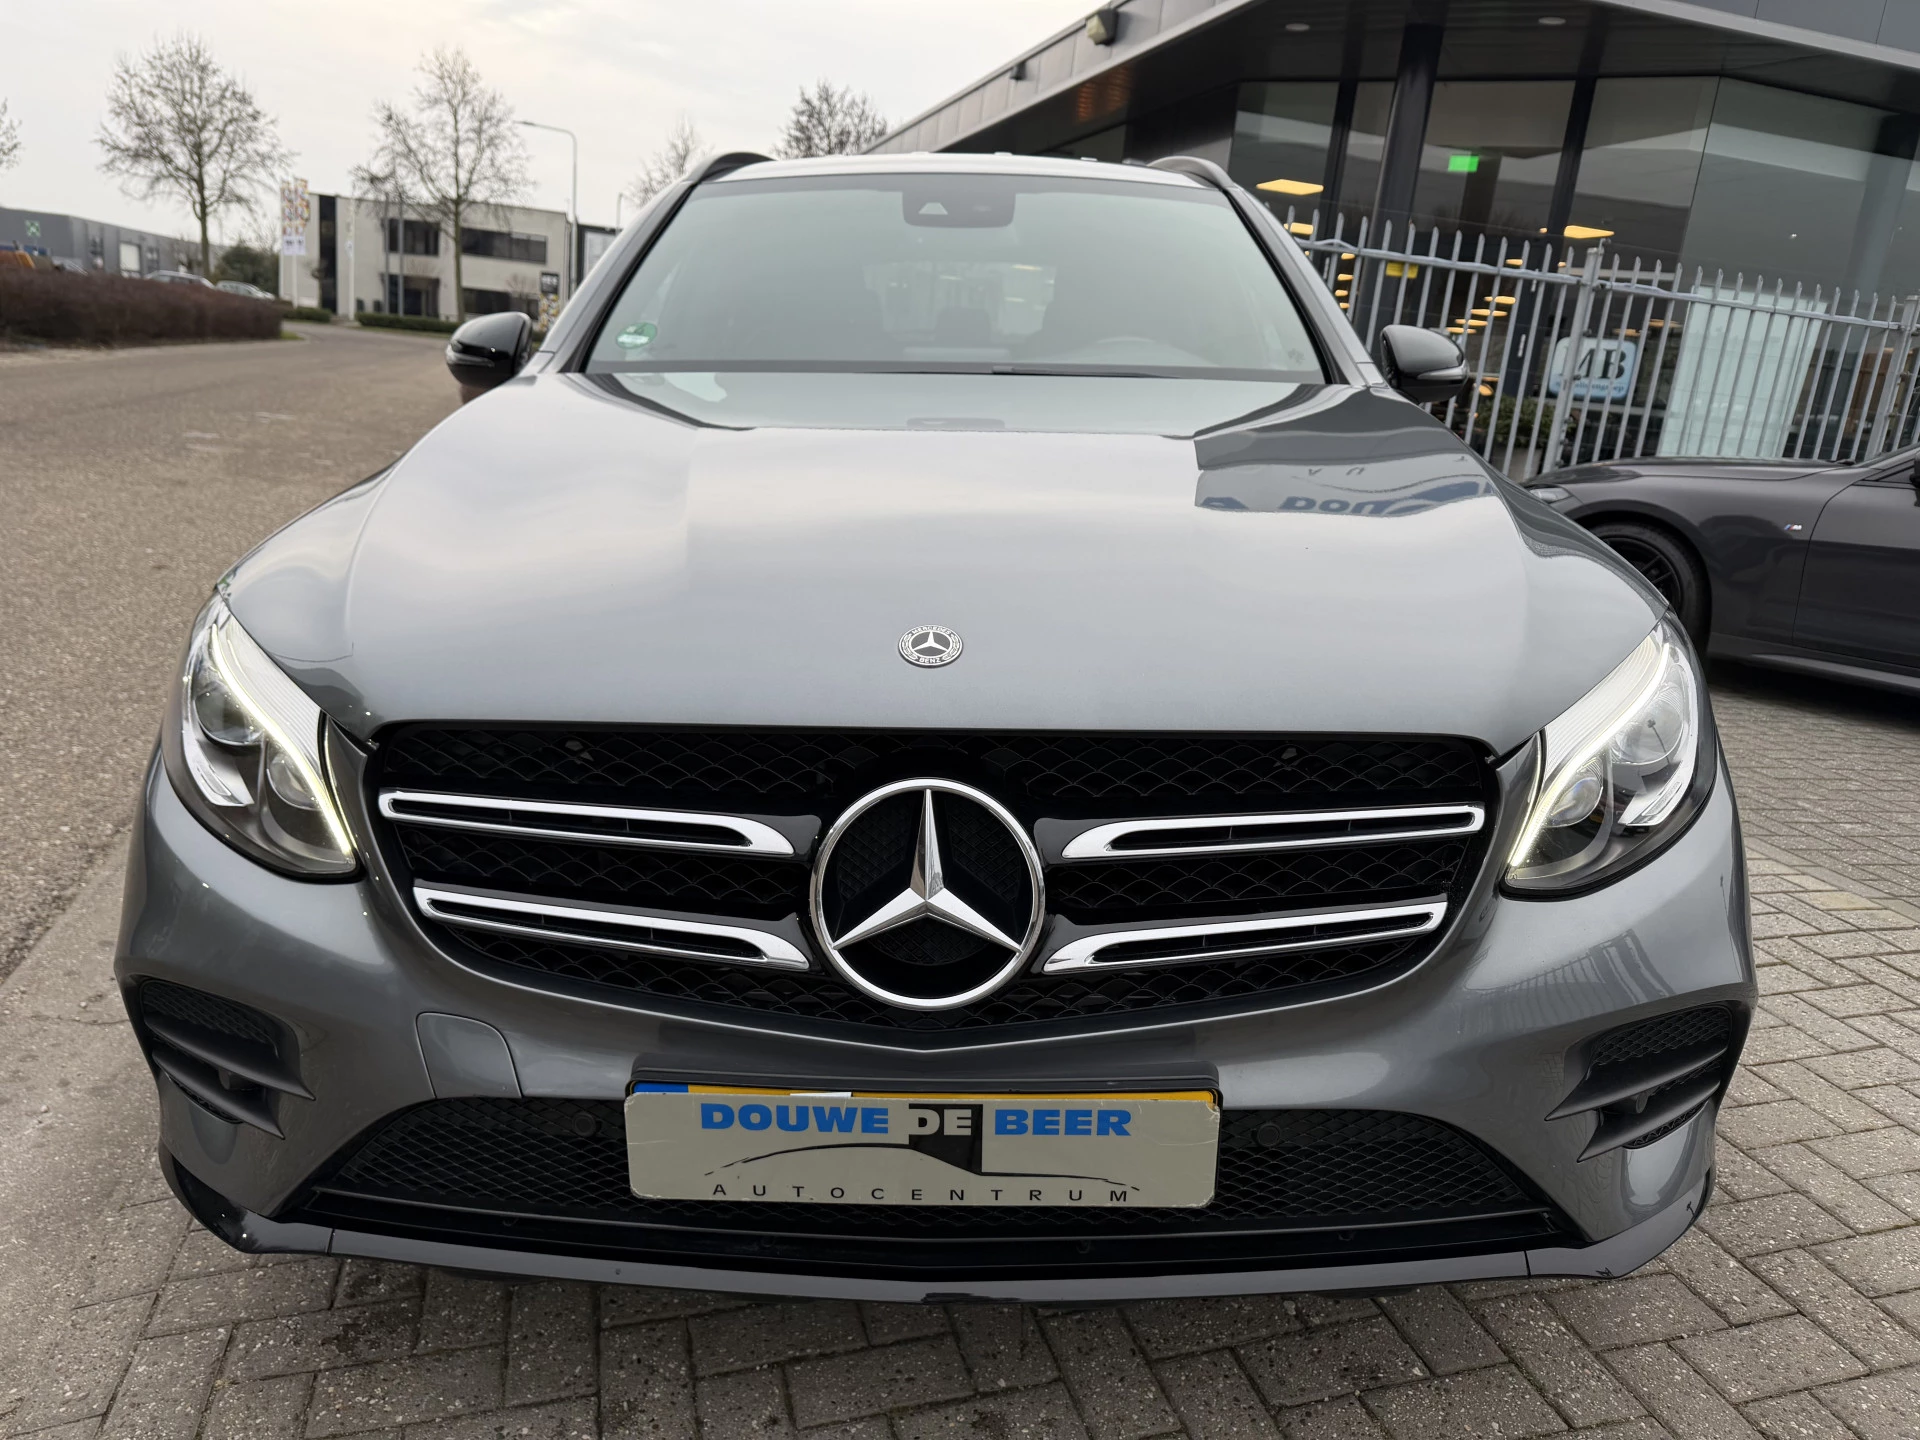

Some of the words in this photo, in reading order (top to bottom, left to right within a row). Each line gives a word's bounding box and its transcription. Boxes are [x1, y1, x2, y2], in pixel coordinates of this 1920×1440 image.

[700, 1102, 889, 1135] DOUWE
[908, 1108, 972, 1136] DE
[994, 1108, 1132, 1137] BEER
[712, 1183, 1128, 1203] AUTOCENTRUM
